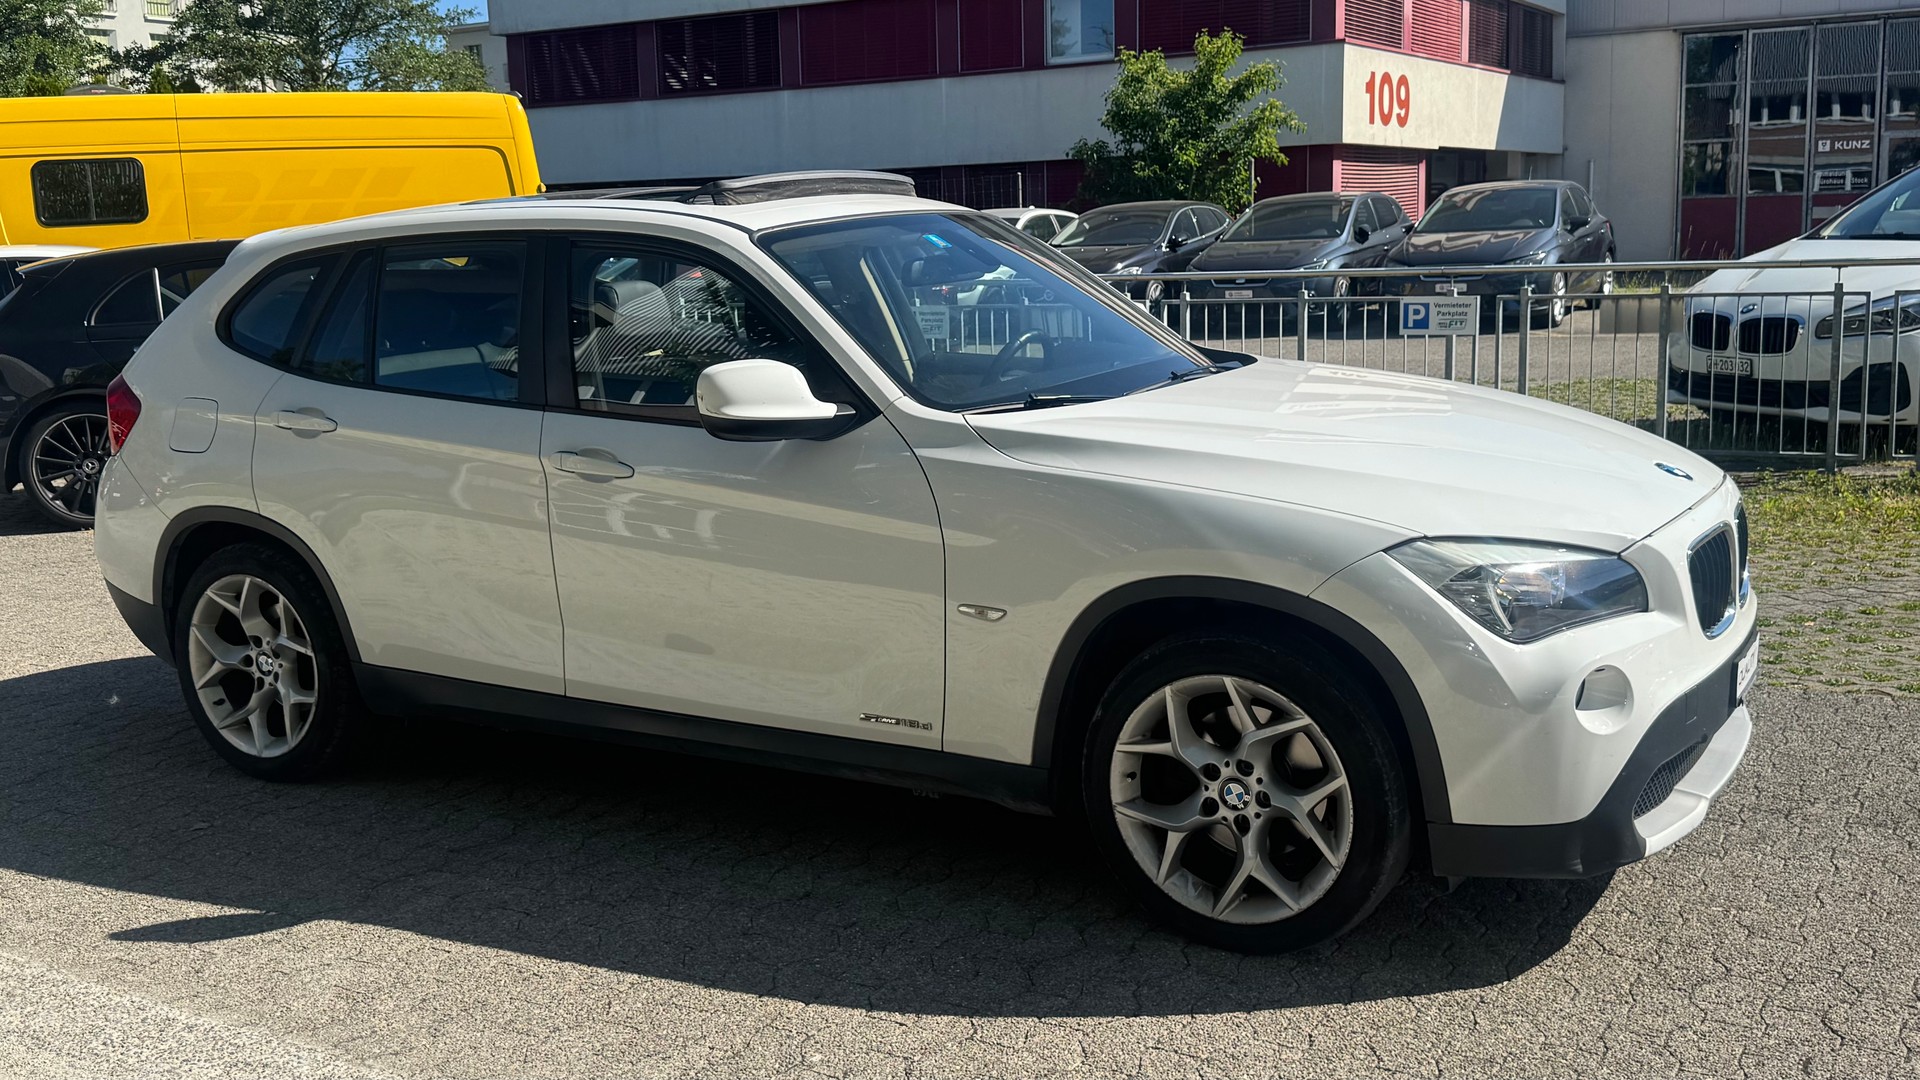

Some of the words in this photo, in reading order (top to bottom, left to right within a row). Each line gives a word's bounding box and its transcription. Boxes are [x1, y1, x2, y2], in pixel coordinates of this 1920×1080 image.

[1365, 71, 1410, 128] 109
[1834, 139, 1871, 150] KUNZ
[1408, 304, 1426, 328] P
[1448, 320, 1465, 328] FIT
